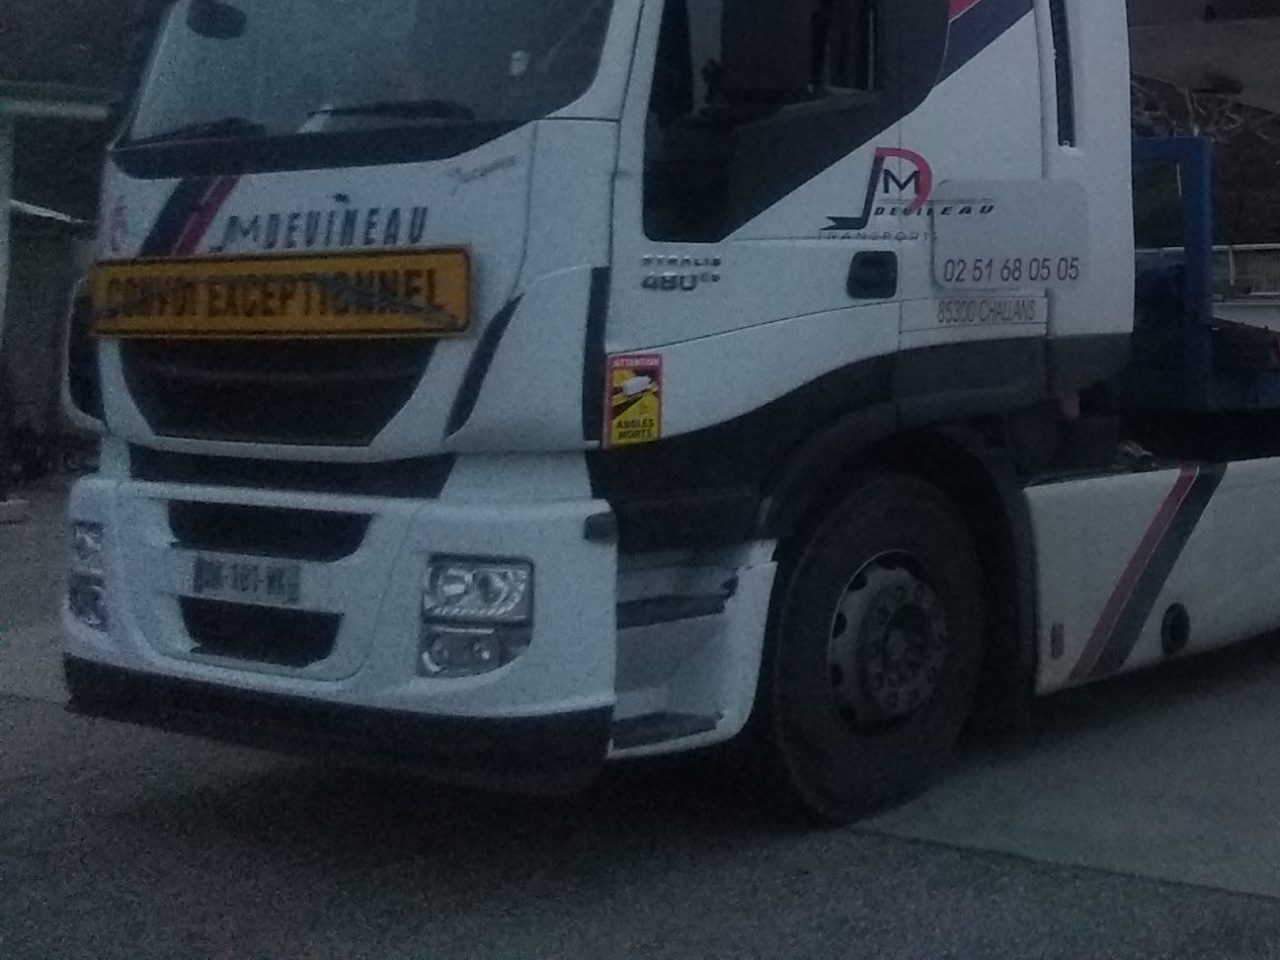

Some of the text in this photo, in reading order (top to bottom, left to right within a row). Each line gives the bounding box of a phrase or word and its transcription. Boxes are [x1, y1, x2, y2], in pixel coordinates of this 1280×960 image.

[943, 256, 1080, 282] 02 51 68 05 05
[978, 298, 1037, 323] CHALLANS
